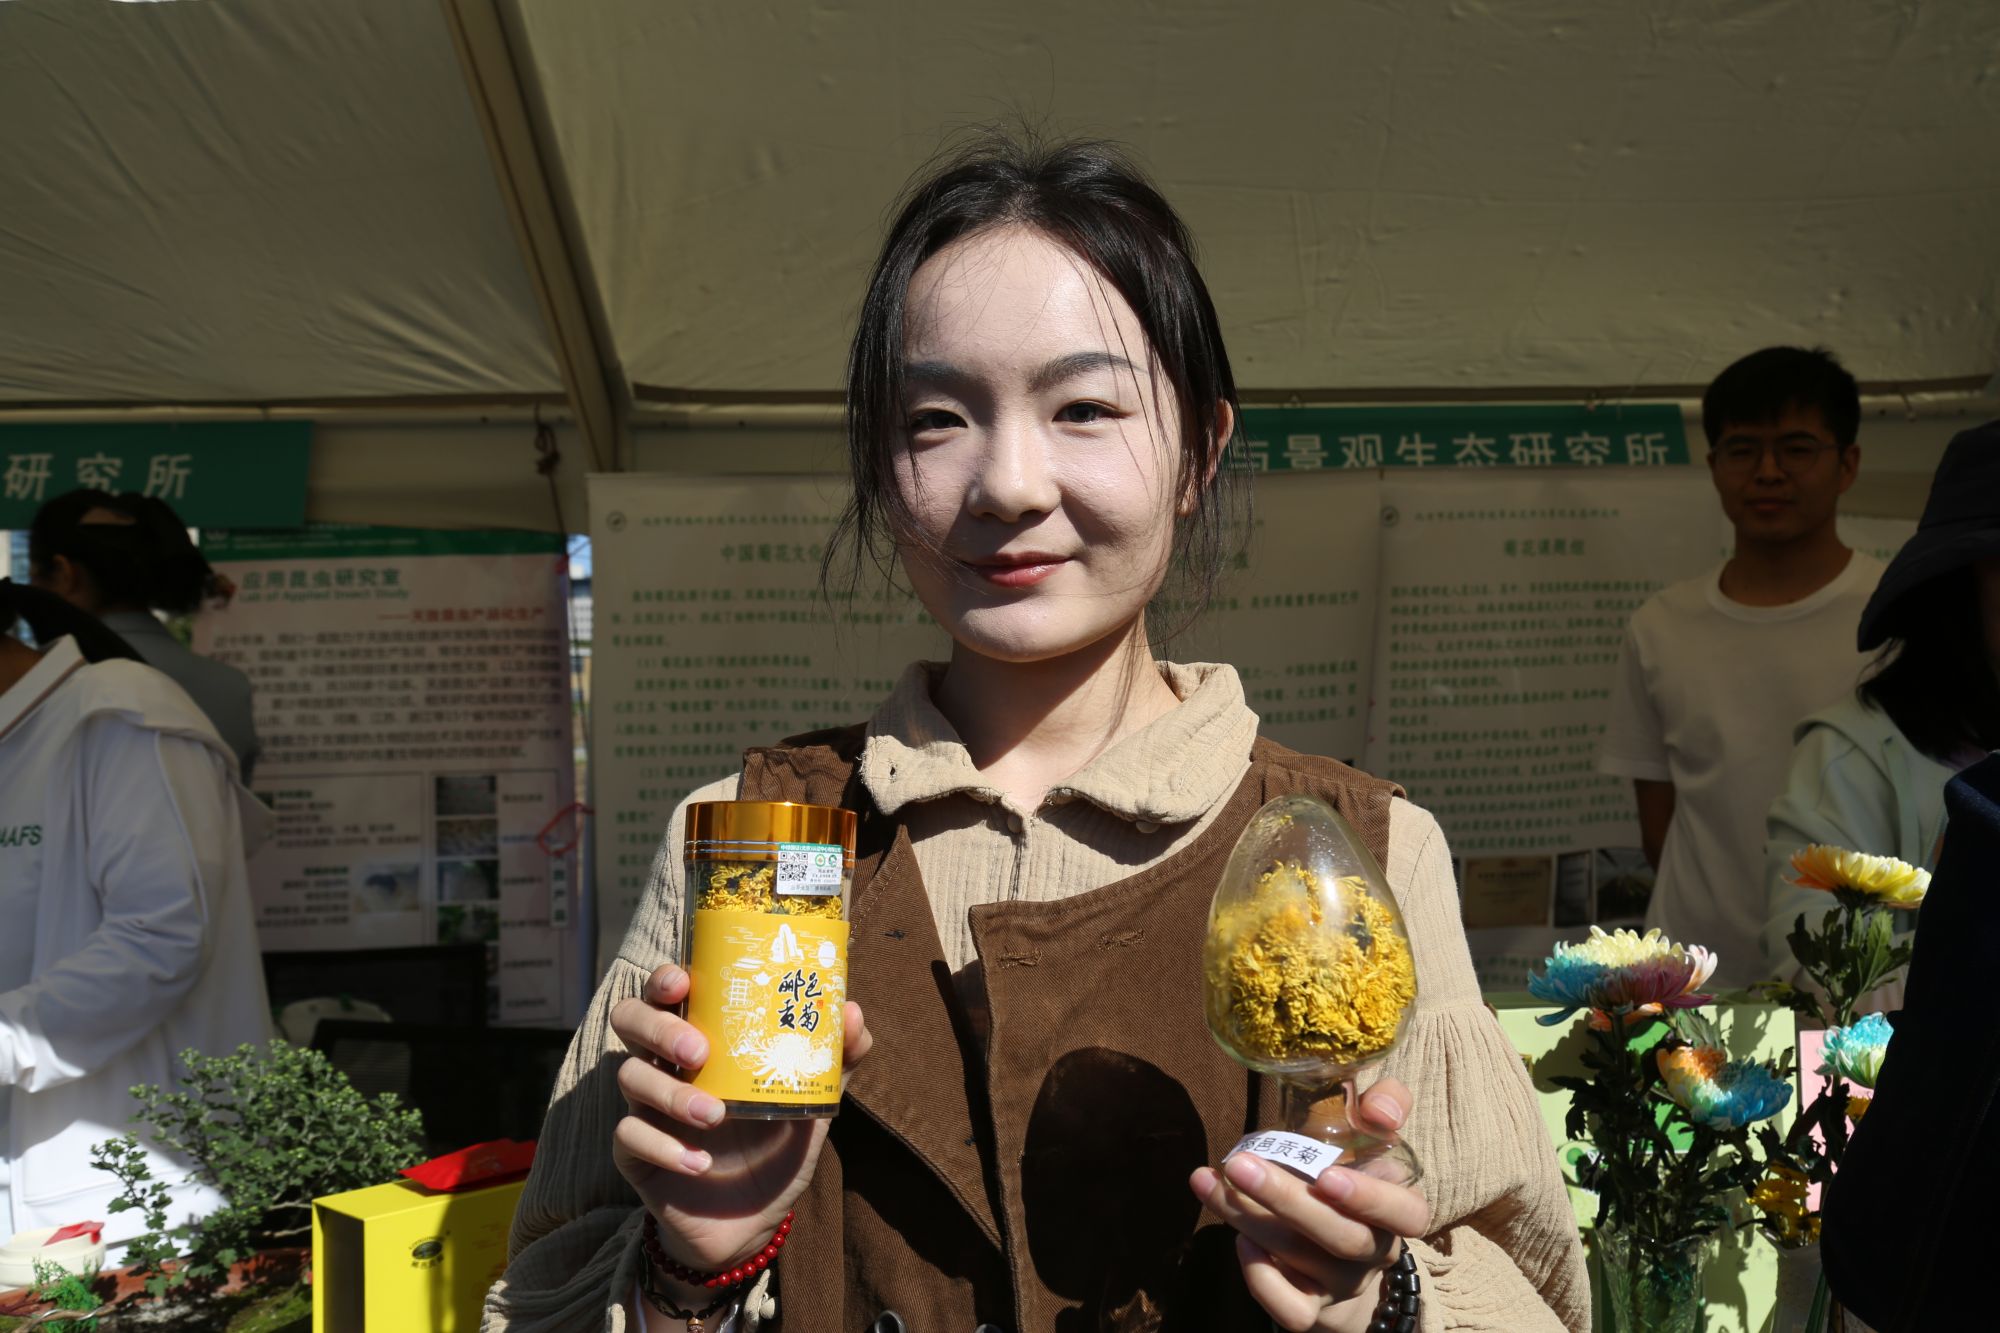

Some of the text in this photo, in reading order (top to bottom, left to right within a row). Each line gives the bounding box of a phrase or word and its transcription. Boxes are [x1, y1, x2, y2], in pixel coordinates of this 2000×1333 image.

[3, 451, 193, 501] 研究所
[242, 567, 401, 590] 应用昆虫研究室
[778, 999, 819, 1033] 贡菊
